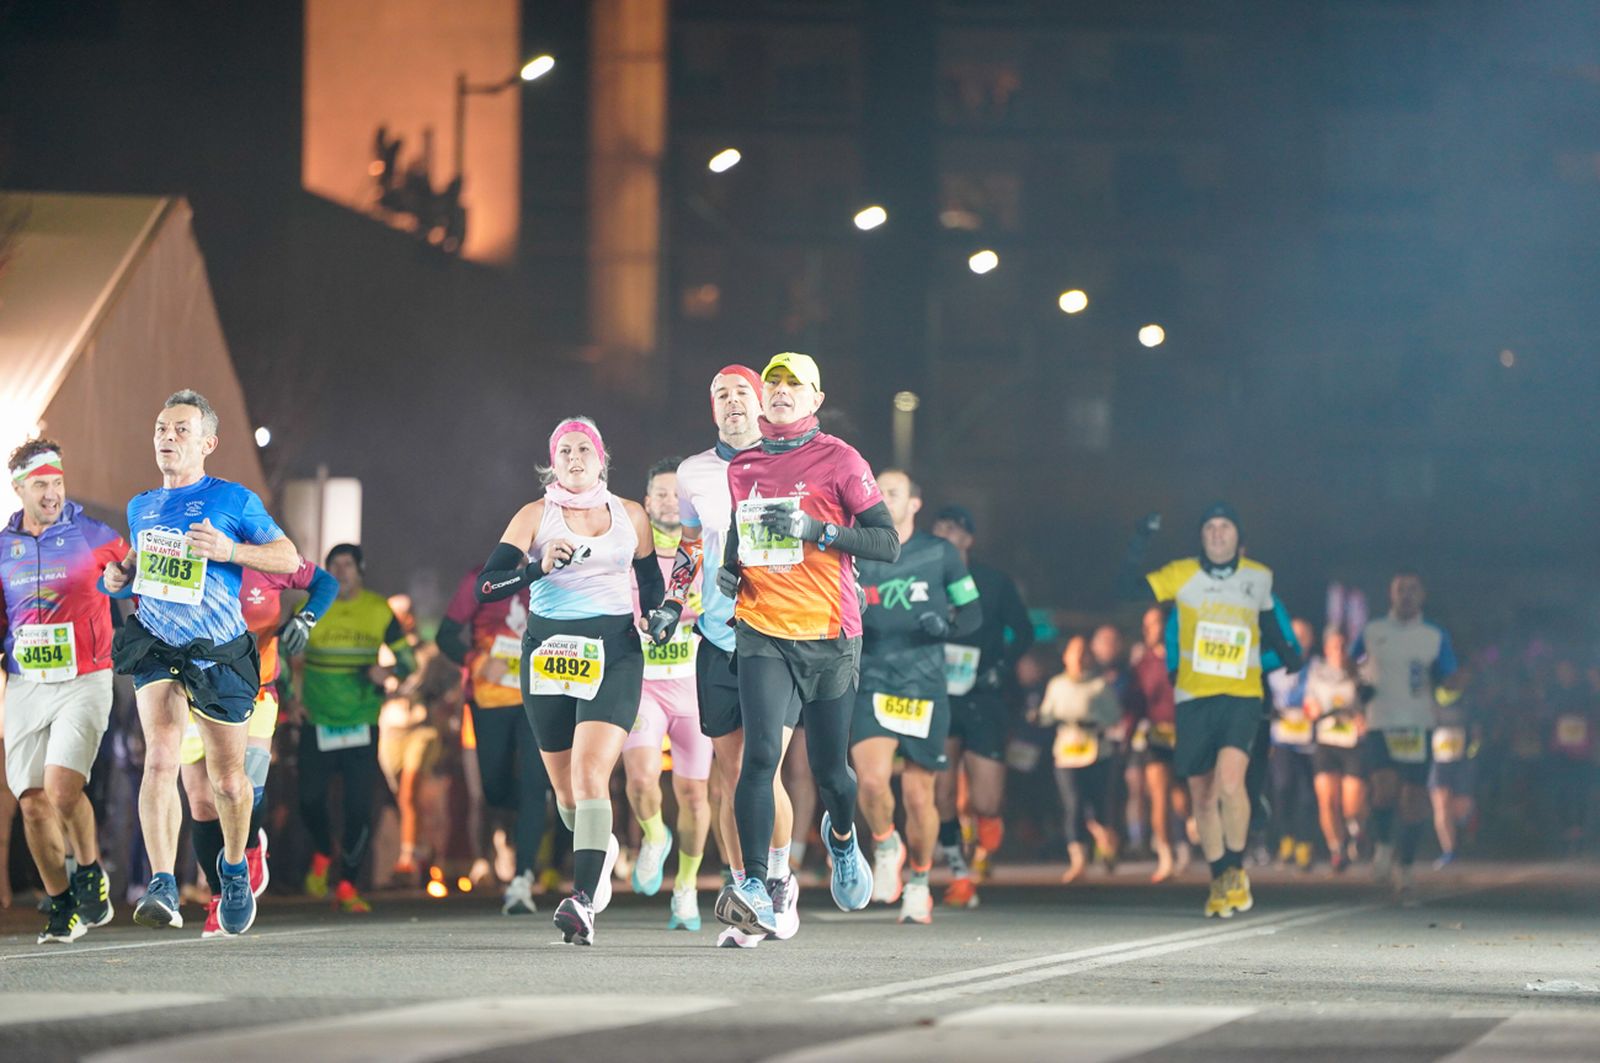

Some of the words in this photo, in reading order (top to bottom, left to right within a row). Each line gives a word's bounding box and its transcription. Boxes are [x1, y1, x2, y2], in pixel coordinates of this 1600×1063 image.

[145, 544, 158, 553] SAN
[153, 537, 172, 547] NOCHE
[173, 541, 182, 549] DE
[148, 553, 193, 581] 2463
[492, 576, 521, 590] COROS
[538, 648, 554, 656] SAN
[547, 641, 568, 649] NOCHE
[648, 641, 689, 660] 8398
[1204, 641, 1242, 660] 12577
[23, 645, 63, 664] 3454
[543, 656, 591, 678] 4892
